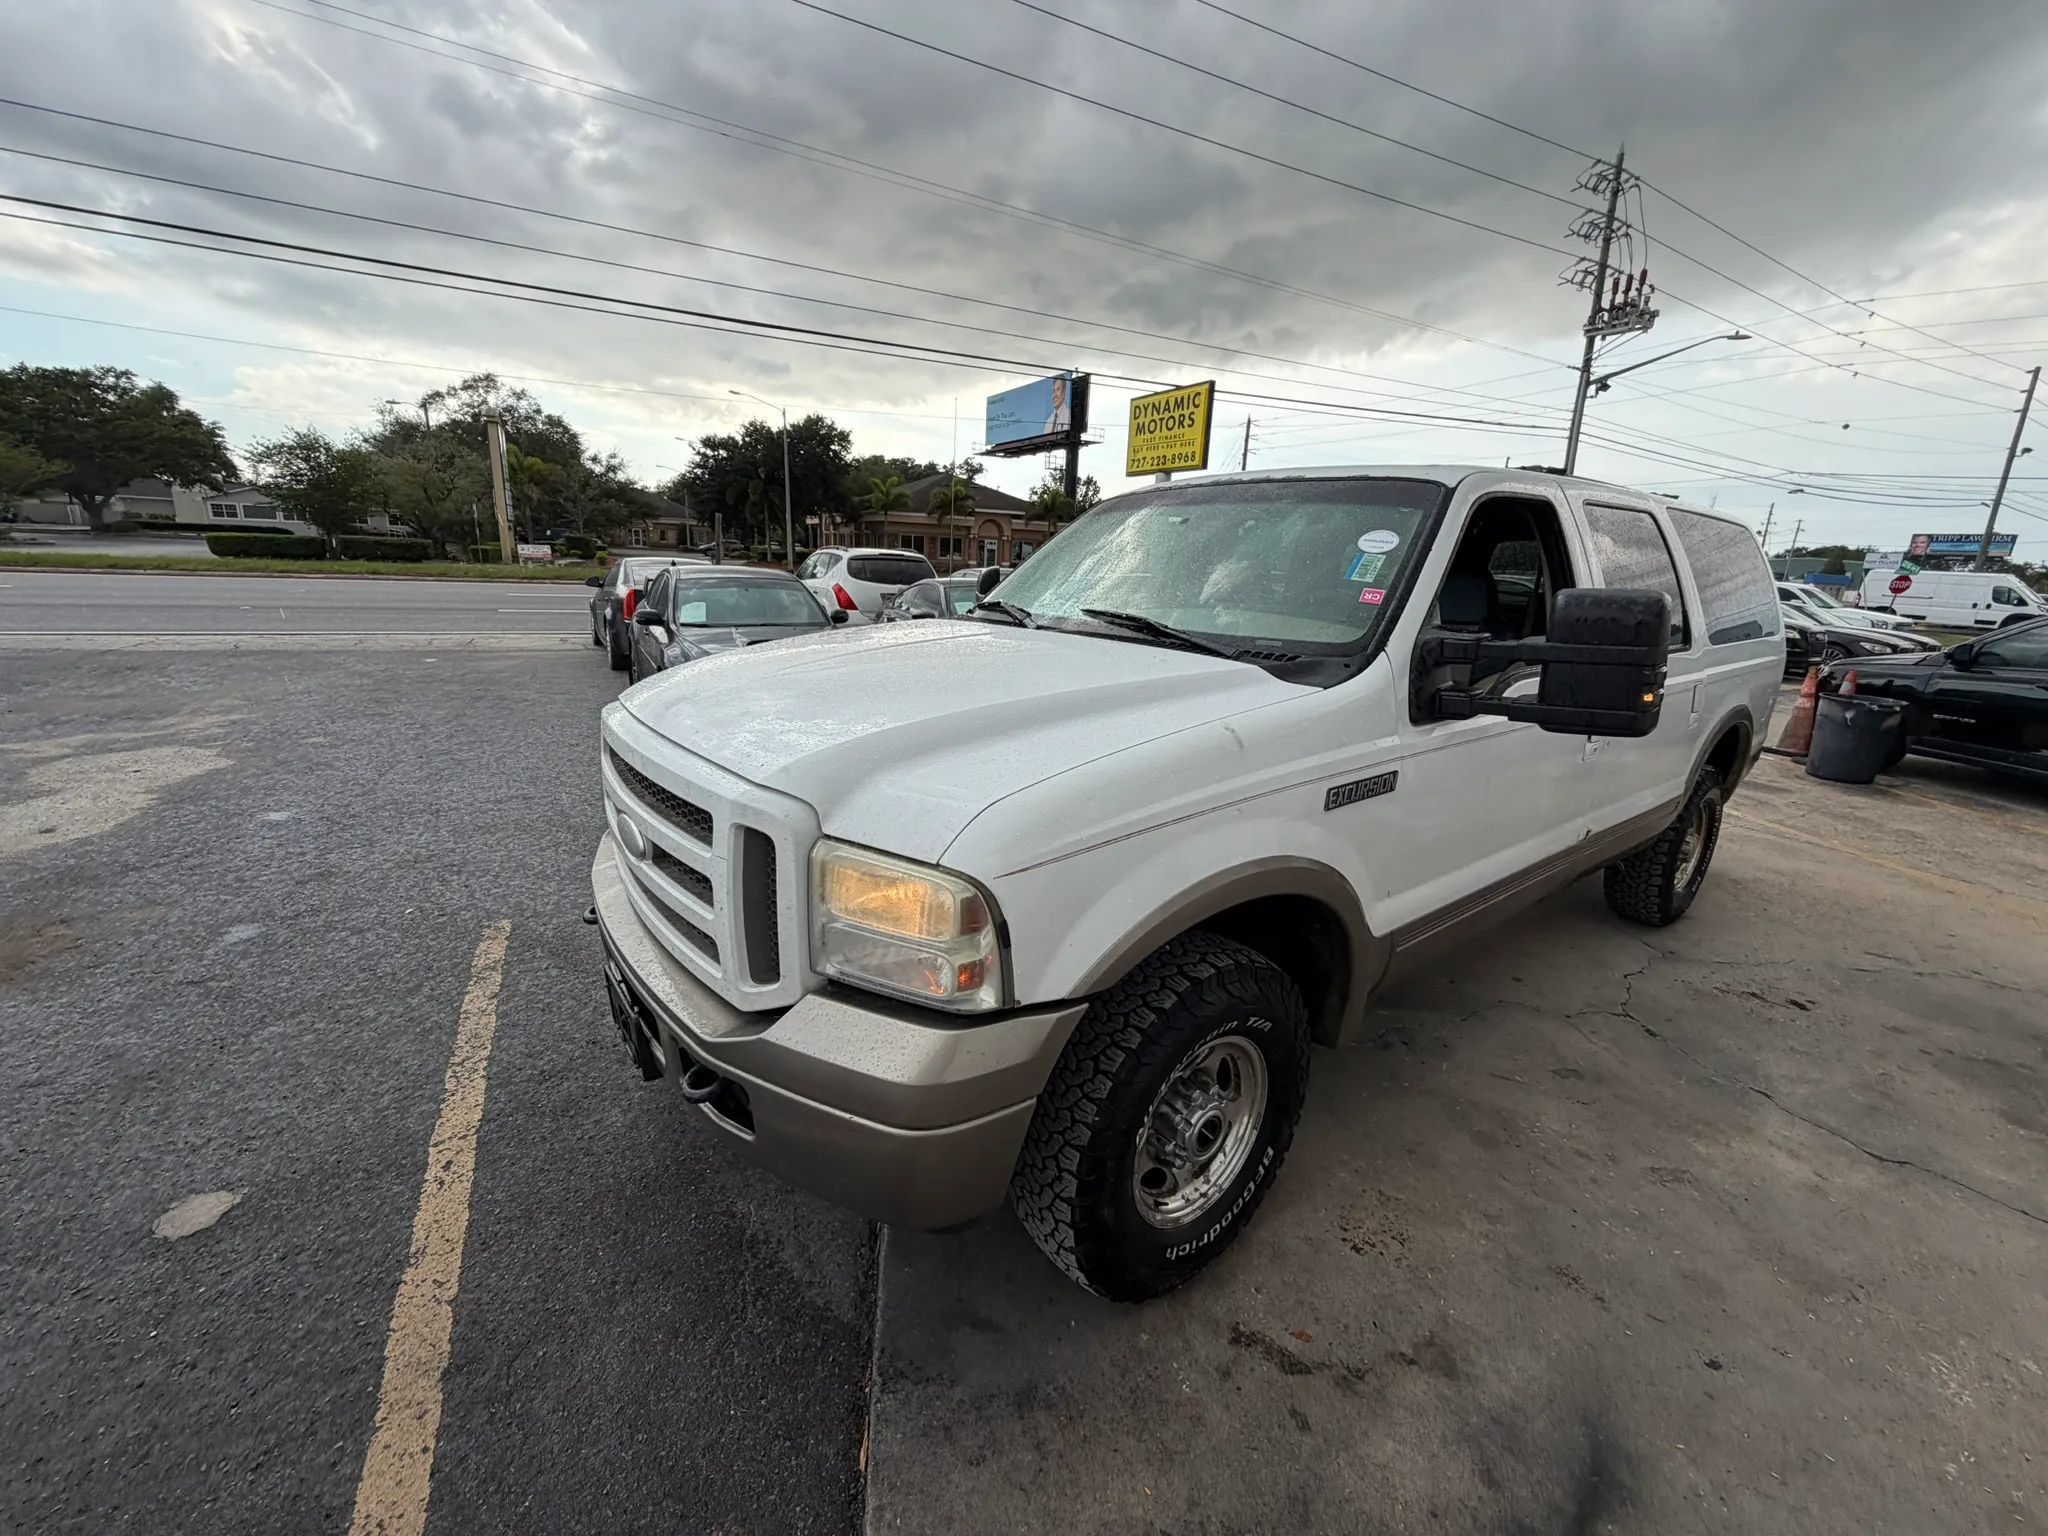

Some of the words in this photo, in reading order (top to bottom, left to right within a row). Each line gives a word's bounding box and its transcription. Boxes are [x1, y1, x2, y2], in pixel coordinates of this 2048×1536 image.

[1134, 392, 1201, 420] DYNAMIC
[1135, 412, 1195, 437] MOTORS
[1159, 433, 1185, 441] FINANCE
[1890, 580, 1912, 589] STOP
[1363, 592, 1380, 600] CR
[1328, 773, 1398, 809] EXCURSION
[1246, 1016, 1273, 1032] T/A
[1166, 1146, 1274, 1260] BFGoodrich
